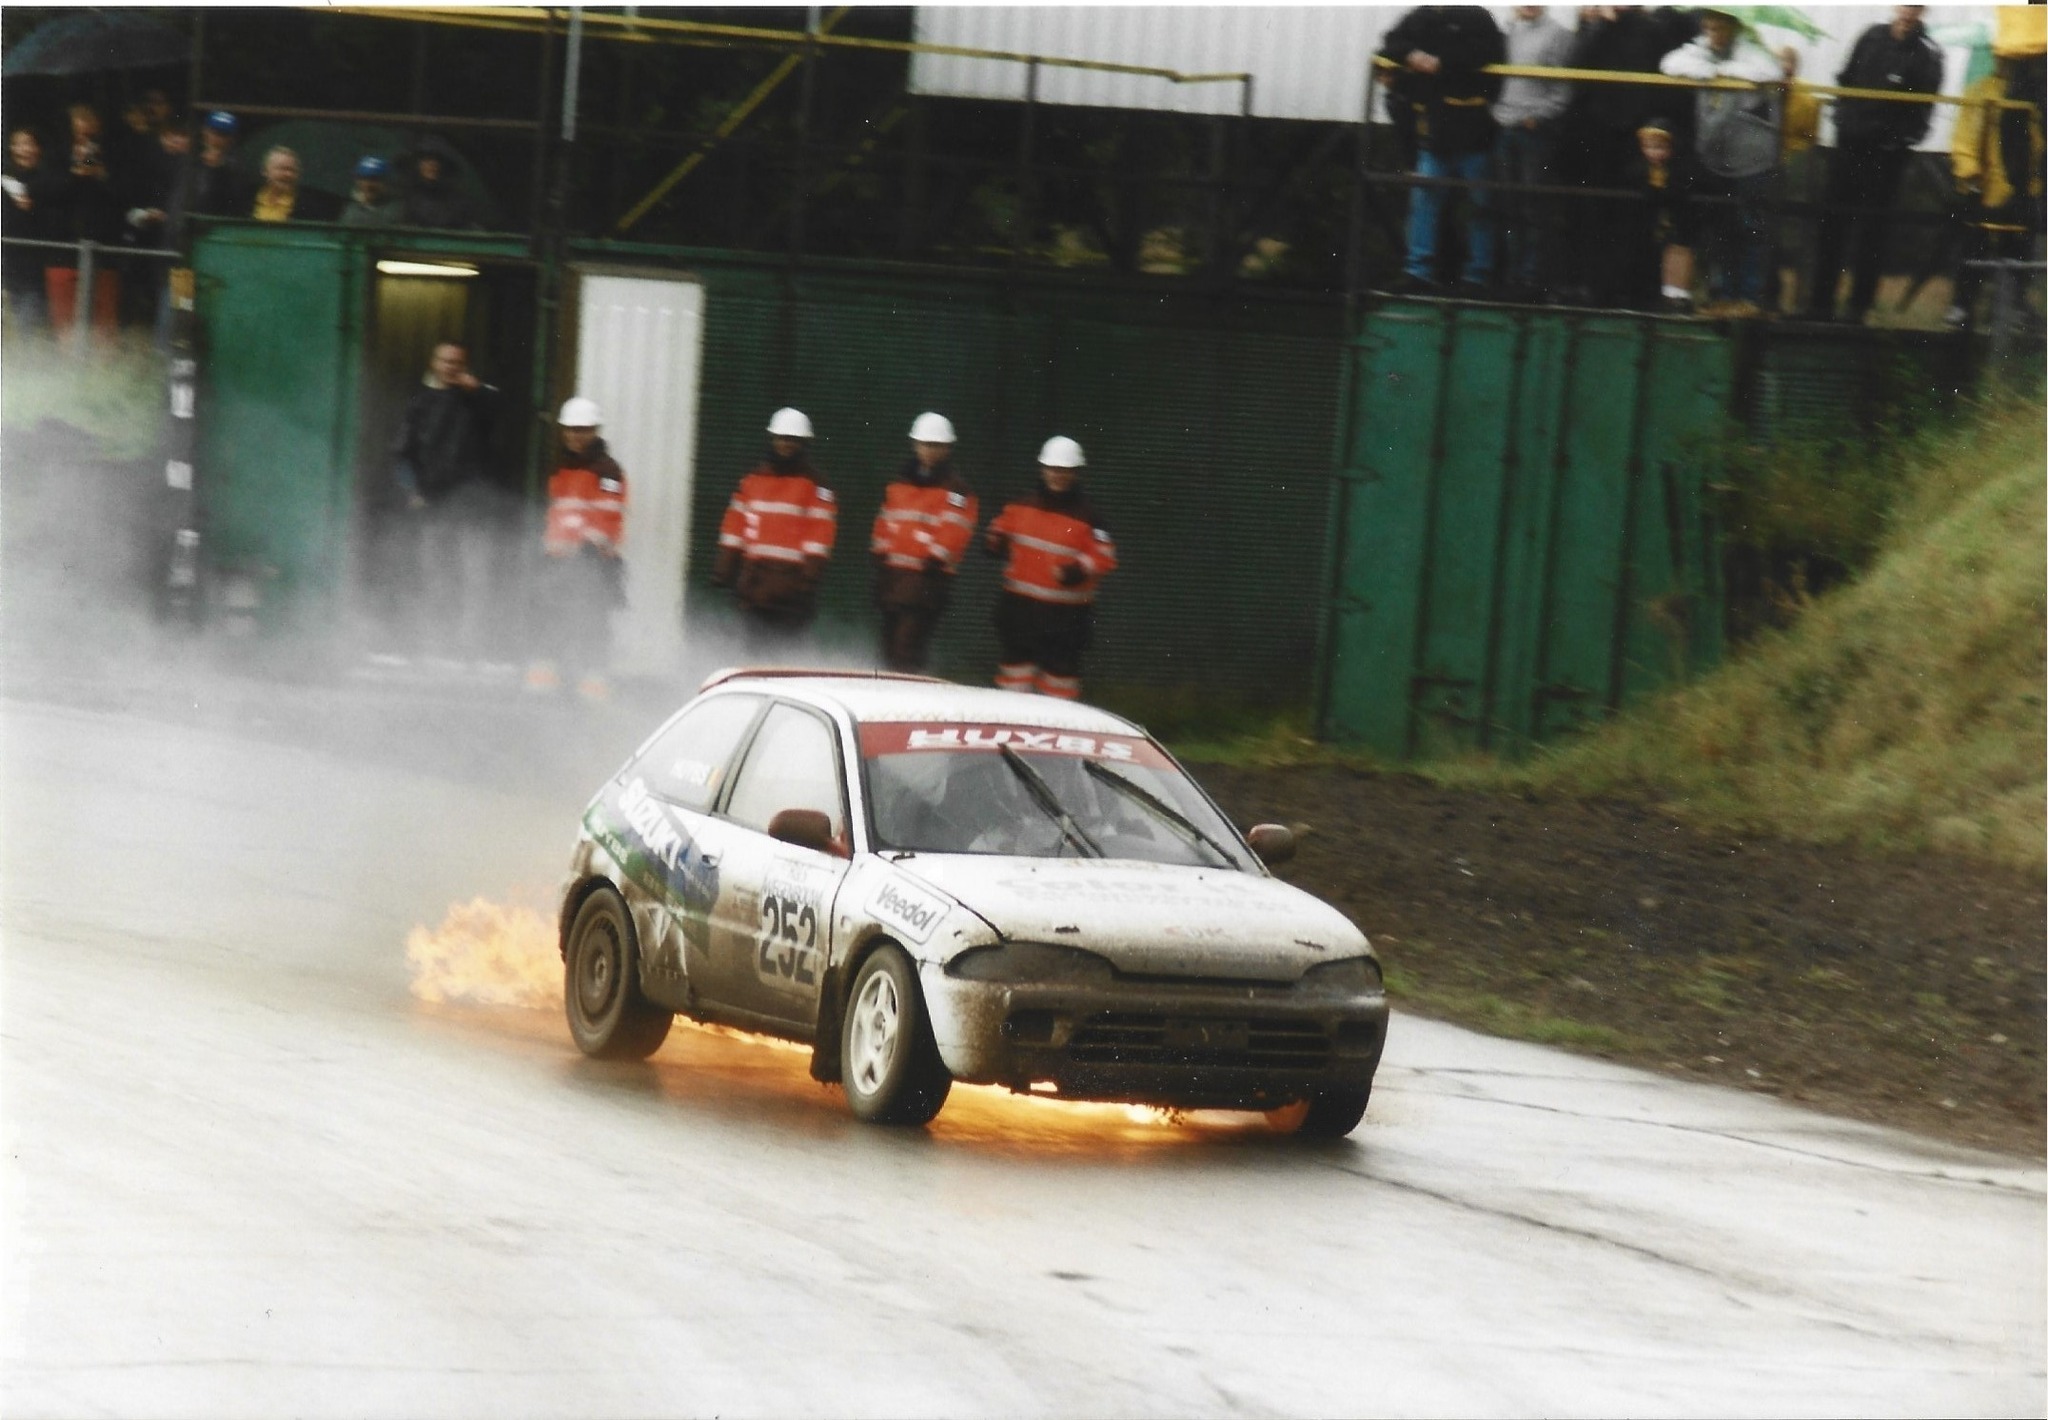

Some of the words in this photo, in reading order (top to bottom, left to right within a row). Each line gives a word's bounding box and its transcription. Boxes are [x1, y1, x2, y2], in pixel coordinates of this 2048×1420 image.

[907, 729, 1132, 760] HUYBS
[618, 777, 683, 870] SUZUKI
[759, 893, 817, 985] 252
[877, 883, 937, 931] Veedol
